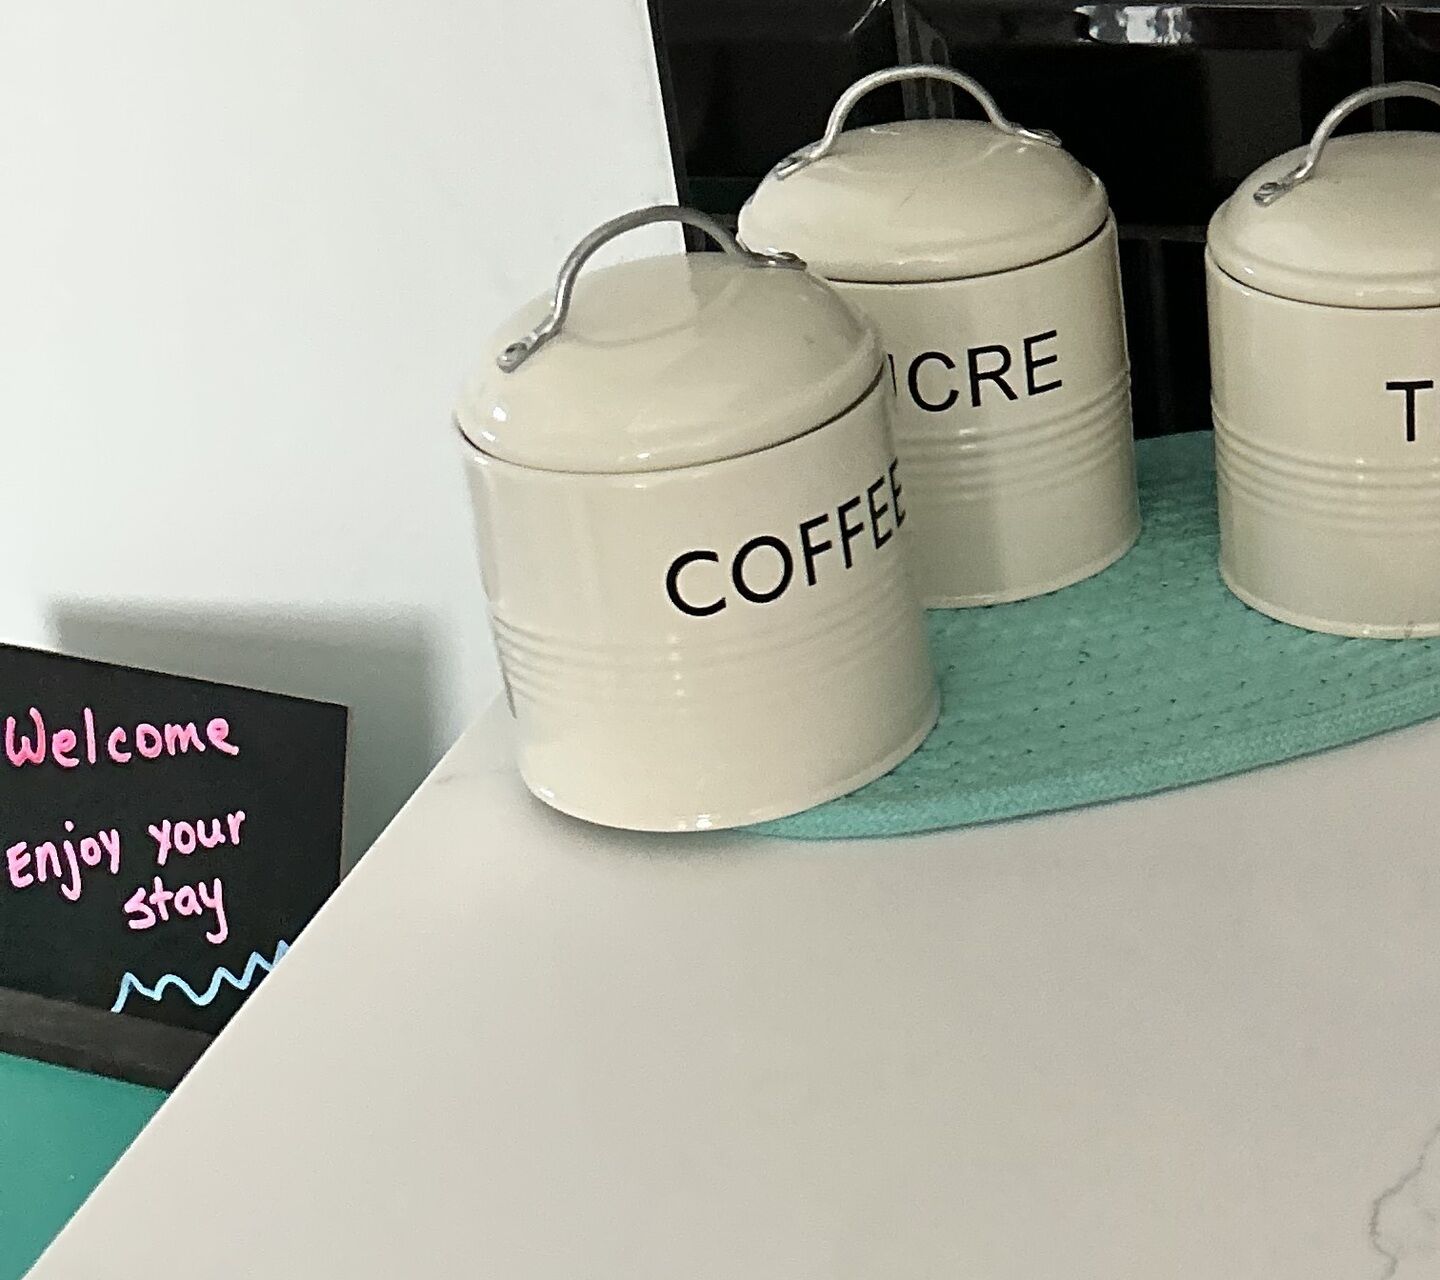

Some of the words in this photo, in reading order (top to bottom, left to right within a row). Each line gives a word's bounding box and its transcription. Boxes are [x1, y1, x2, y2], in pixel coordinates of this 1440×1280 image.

[888, 329, 1063, 412] CRE
[665, 457, 907, 617] COFFEE
[5, 706, 240, 769] Welcome
[5, 820, 121, 902] Enjoy
[147, 809, 247, 867] your
[122, 876, 230, 945] stay
